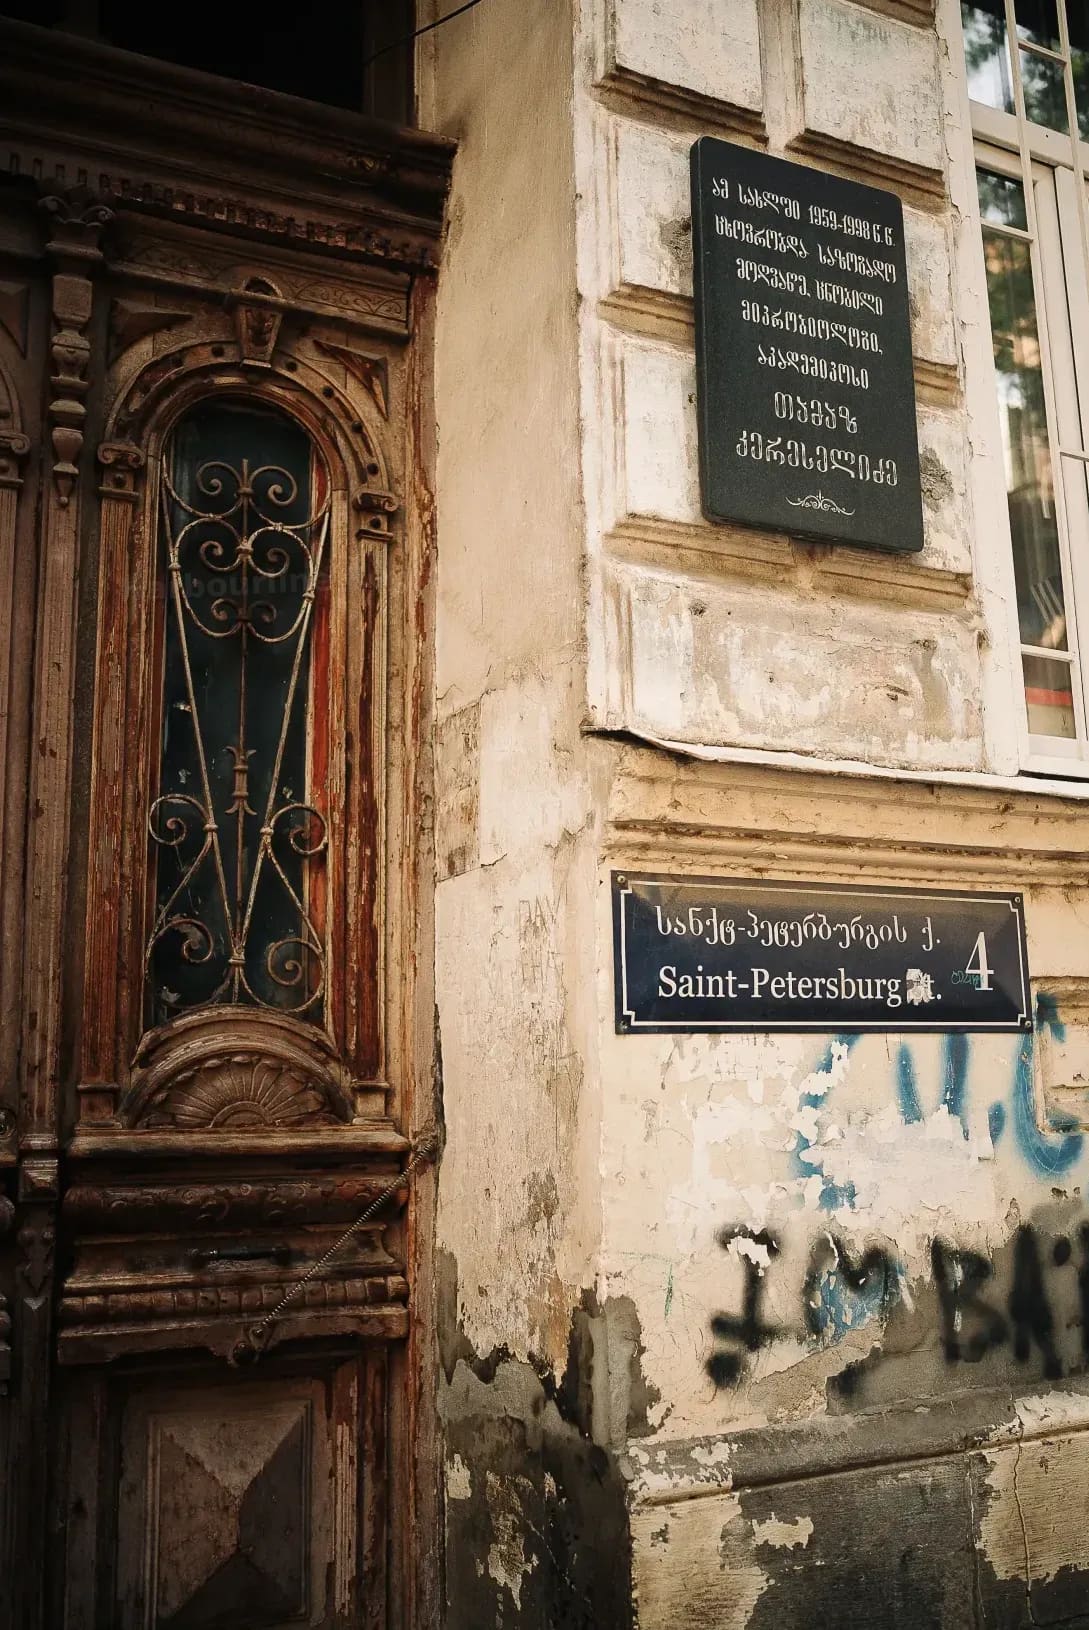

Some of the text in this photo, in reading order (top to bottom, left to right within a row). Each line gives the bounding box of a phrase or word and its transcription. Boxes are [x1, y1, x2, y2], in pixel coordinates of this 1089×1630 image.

[712, 177, 729, 199] ამ
[737, 183, 800, 221] სახლში
[807, 204, 871, 241] 1959-1998
[714, 213, 897, 284] ცხოვრობდა საზოგადო
[735, 257, 884, 316] მოღვაწე, ცნობილი
[740, 299, 883, 356] მიკრობიოლოგი,
[757, 343, 870, 390] აკადემიკოსი
[774, 391, 859, 434] თამაზ
[735, 430, 898, 487] კერესელიძე
[653, 905, 942, 951] სანქტ-პეტერბურგის ქ.
[658, 965, 902, 1008] Saint-Petersburg
[965, 931, 995, 991] 4
